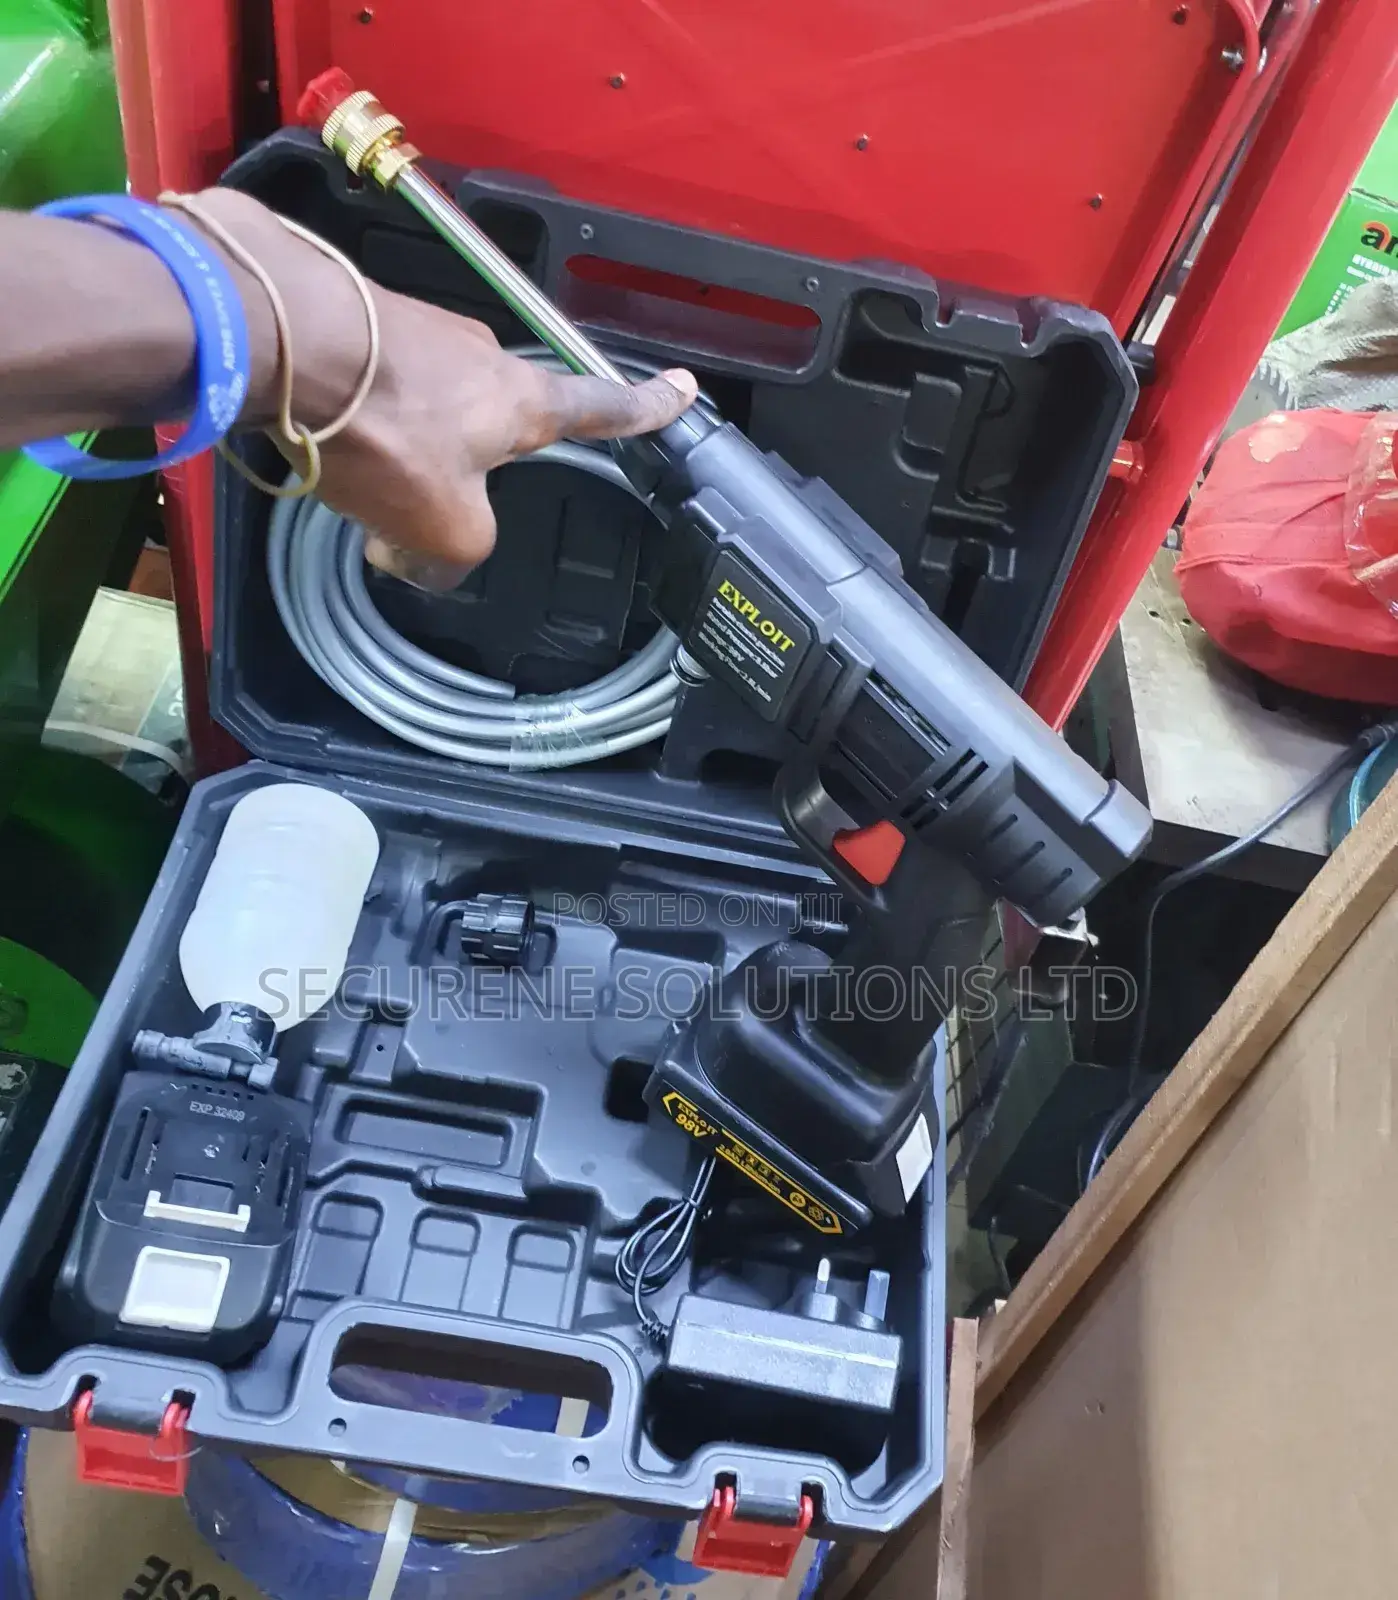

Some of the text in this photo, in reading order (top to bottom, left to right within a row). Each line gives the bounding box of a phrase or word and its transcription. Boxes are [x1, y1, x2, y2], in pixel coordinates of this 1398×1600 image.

[718, 580, 795, 652] EXPLOIT
[189, 1101, 213, 1114] EXP
[677, 1103, 718, 1135] EXPLOIT
[676, 1113, 707, 1138] 98V
